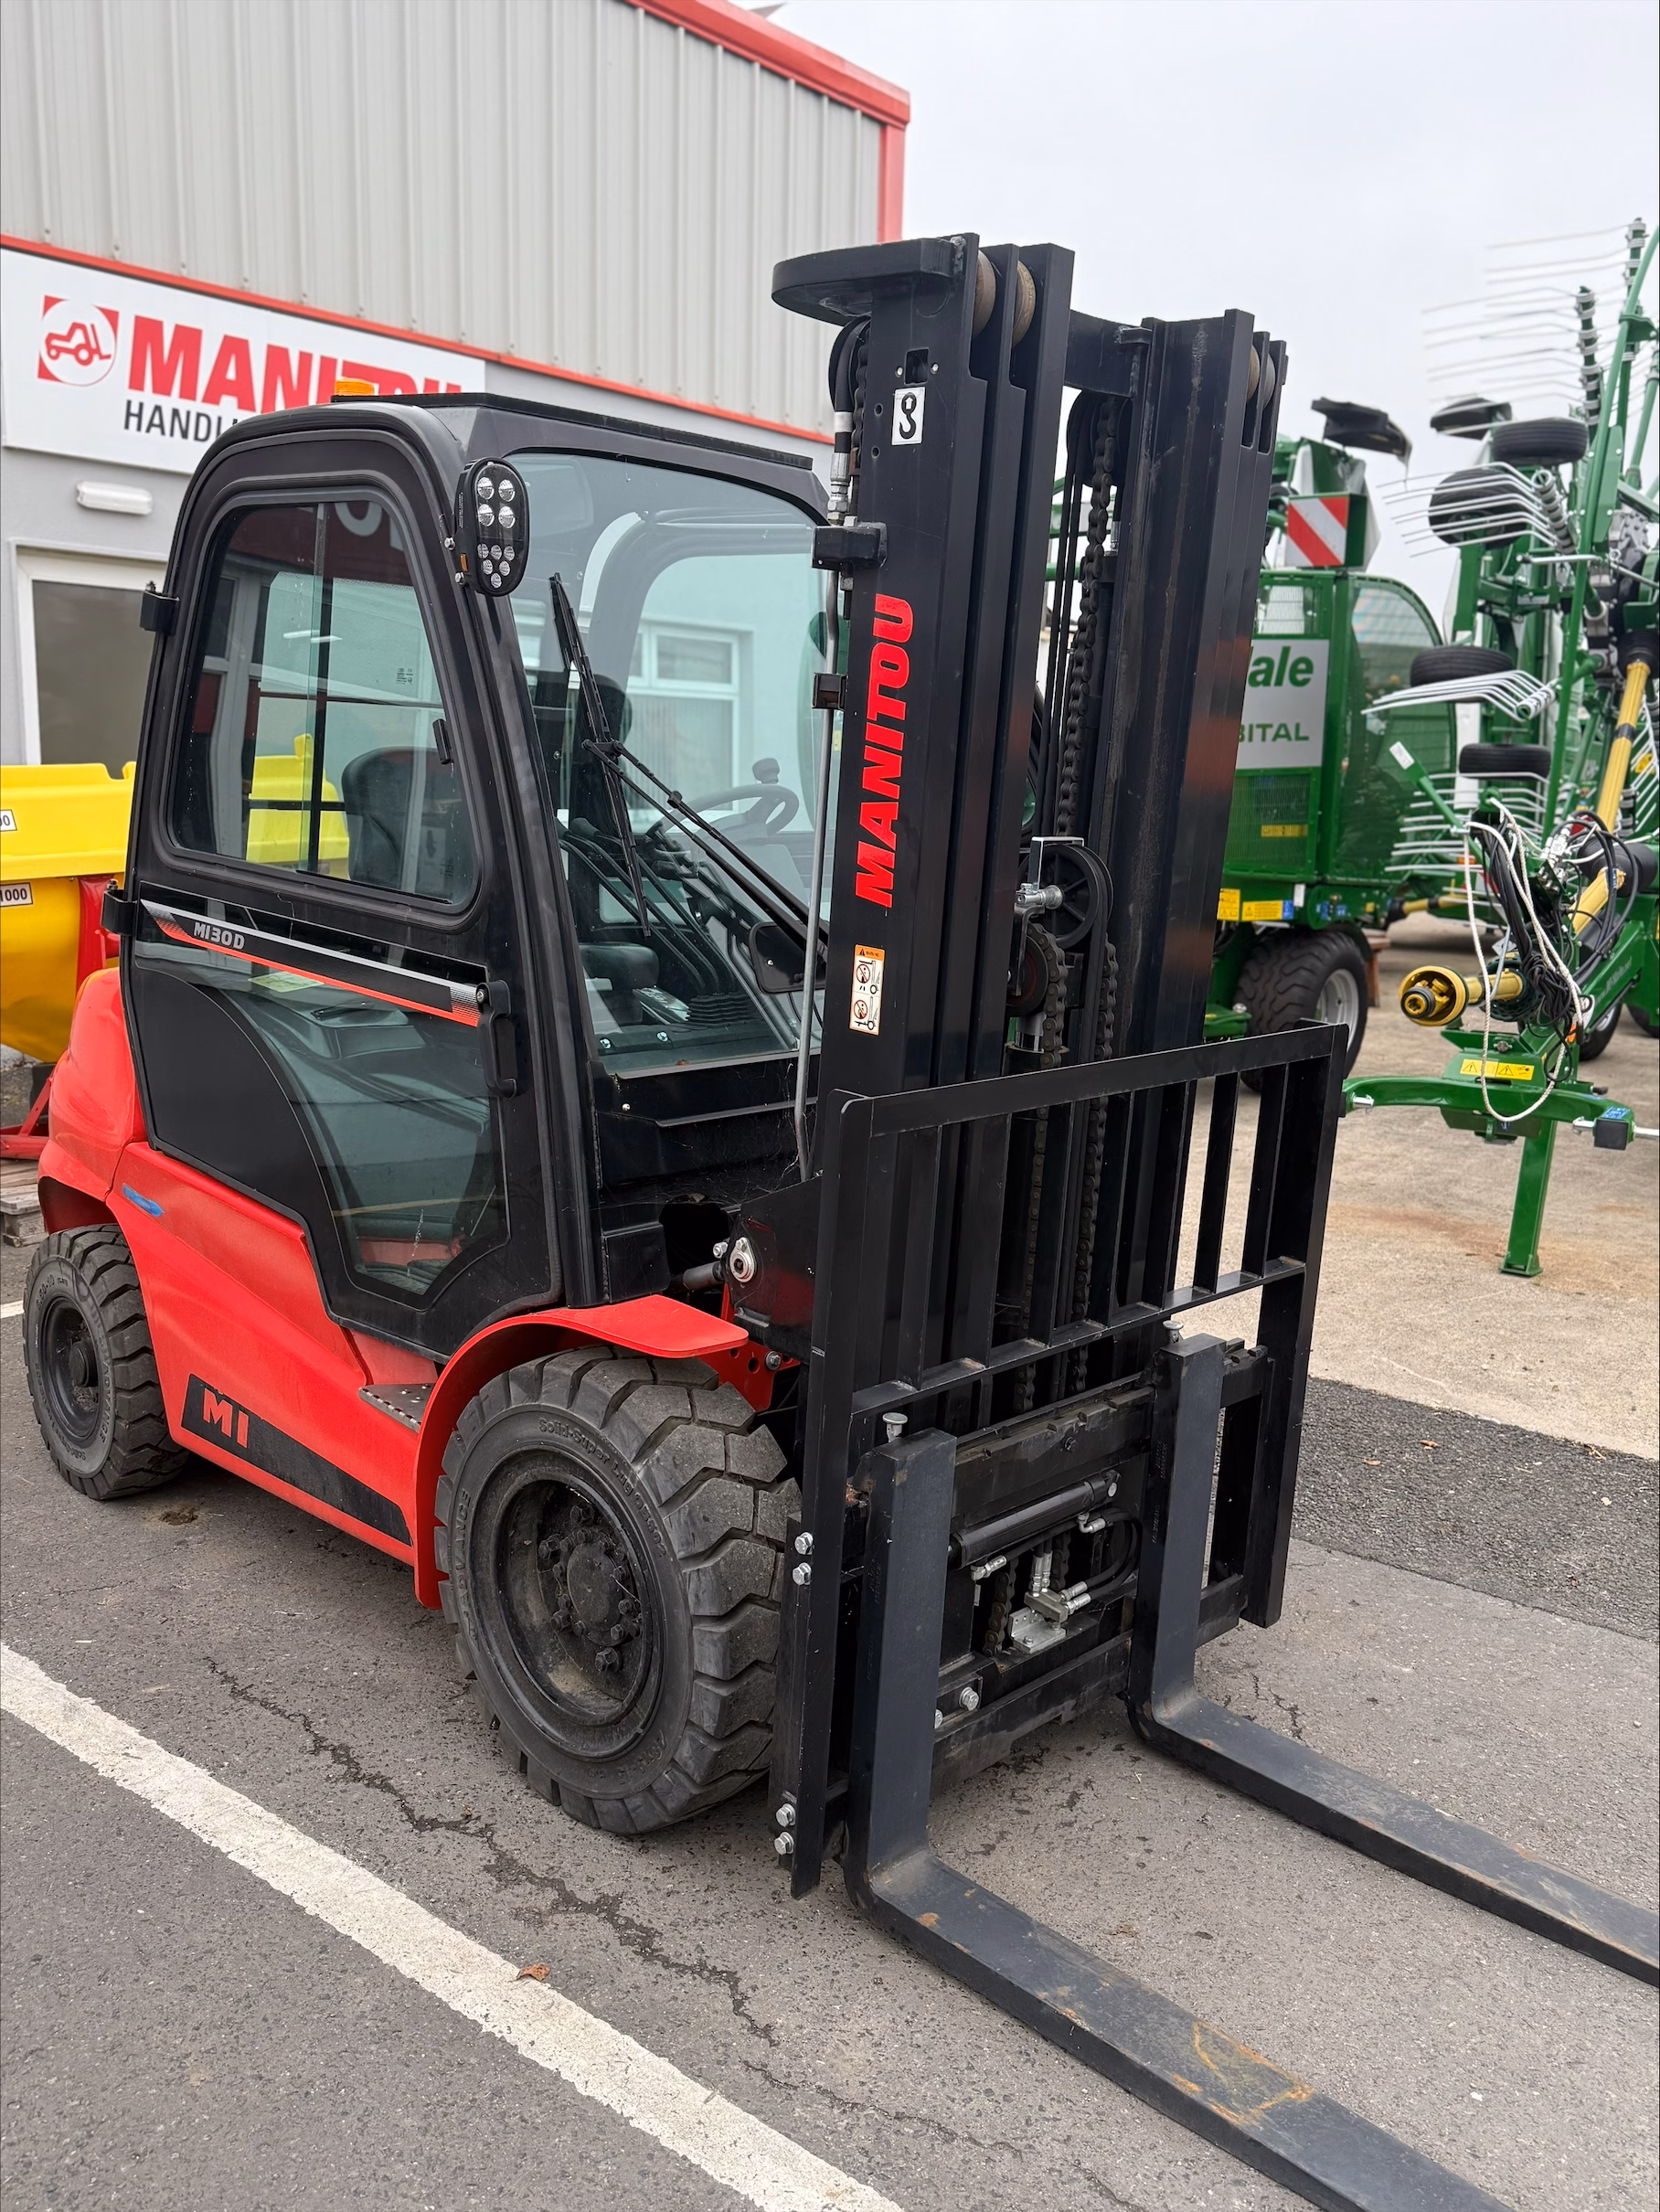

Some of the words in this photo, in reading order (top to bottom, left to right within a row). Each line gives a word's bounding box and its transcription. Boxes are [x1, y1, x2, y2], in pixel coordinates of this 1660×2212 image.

[127, 314, 463, 414] MANI
[124, 399, 239, 442] HANDL
[1247, 645, 1314, 688] ale
[856, 593, 913, 909] MANITOU
[1239, 722, 1310, 742] ITAL
[203, 1388, 249, 1449] MI
[538, 1417, 611, 1464] Solid-Super
